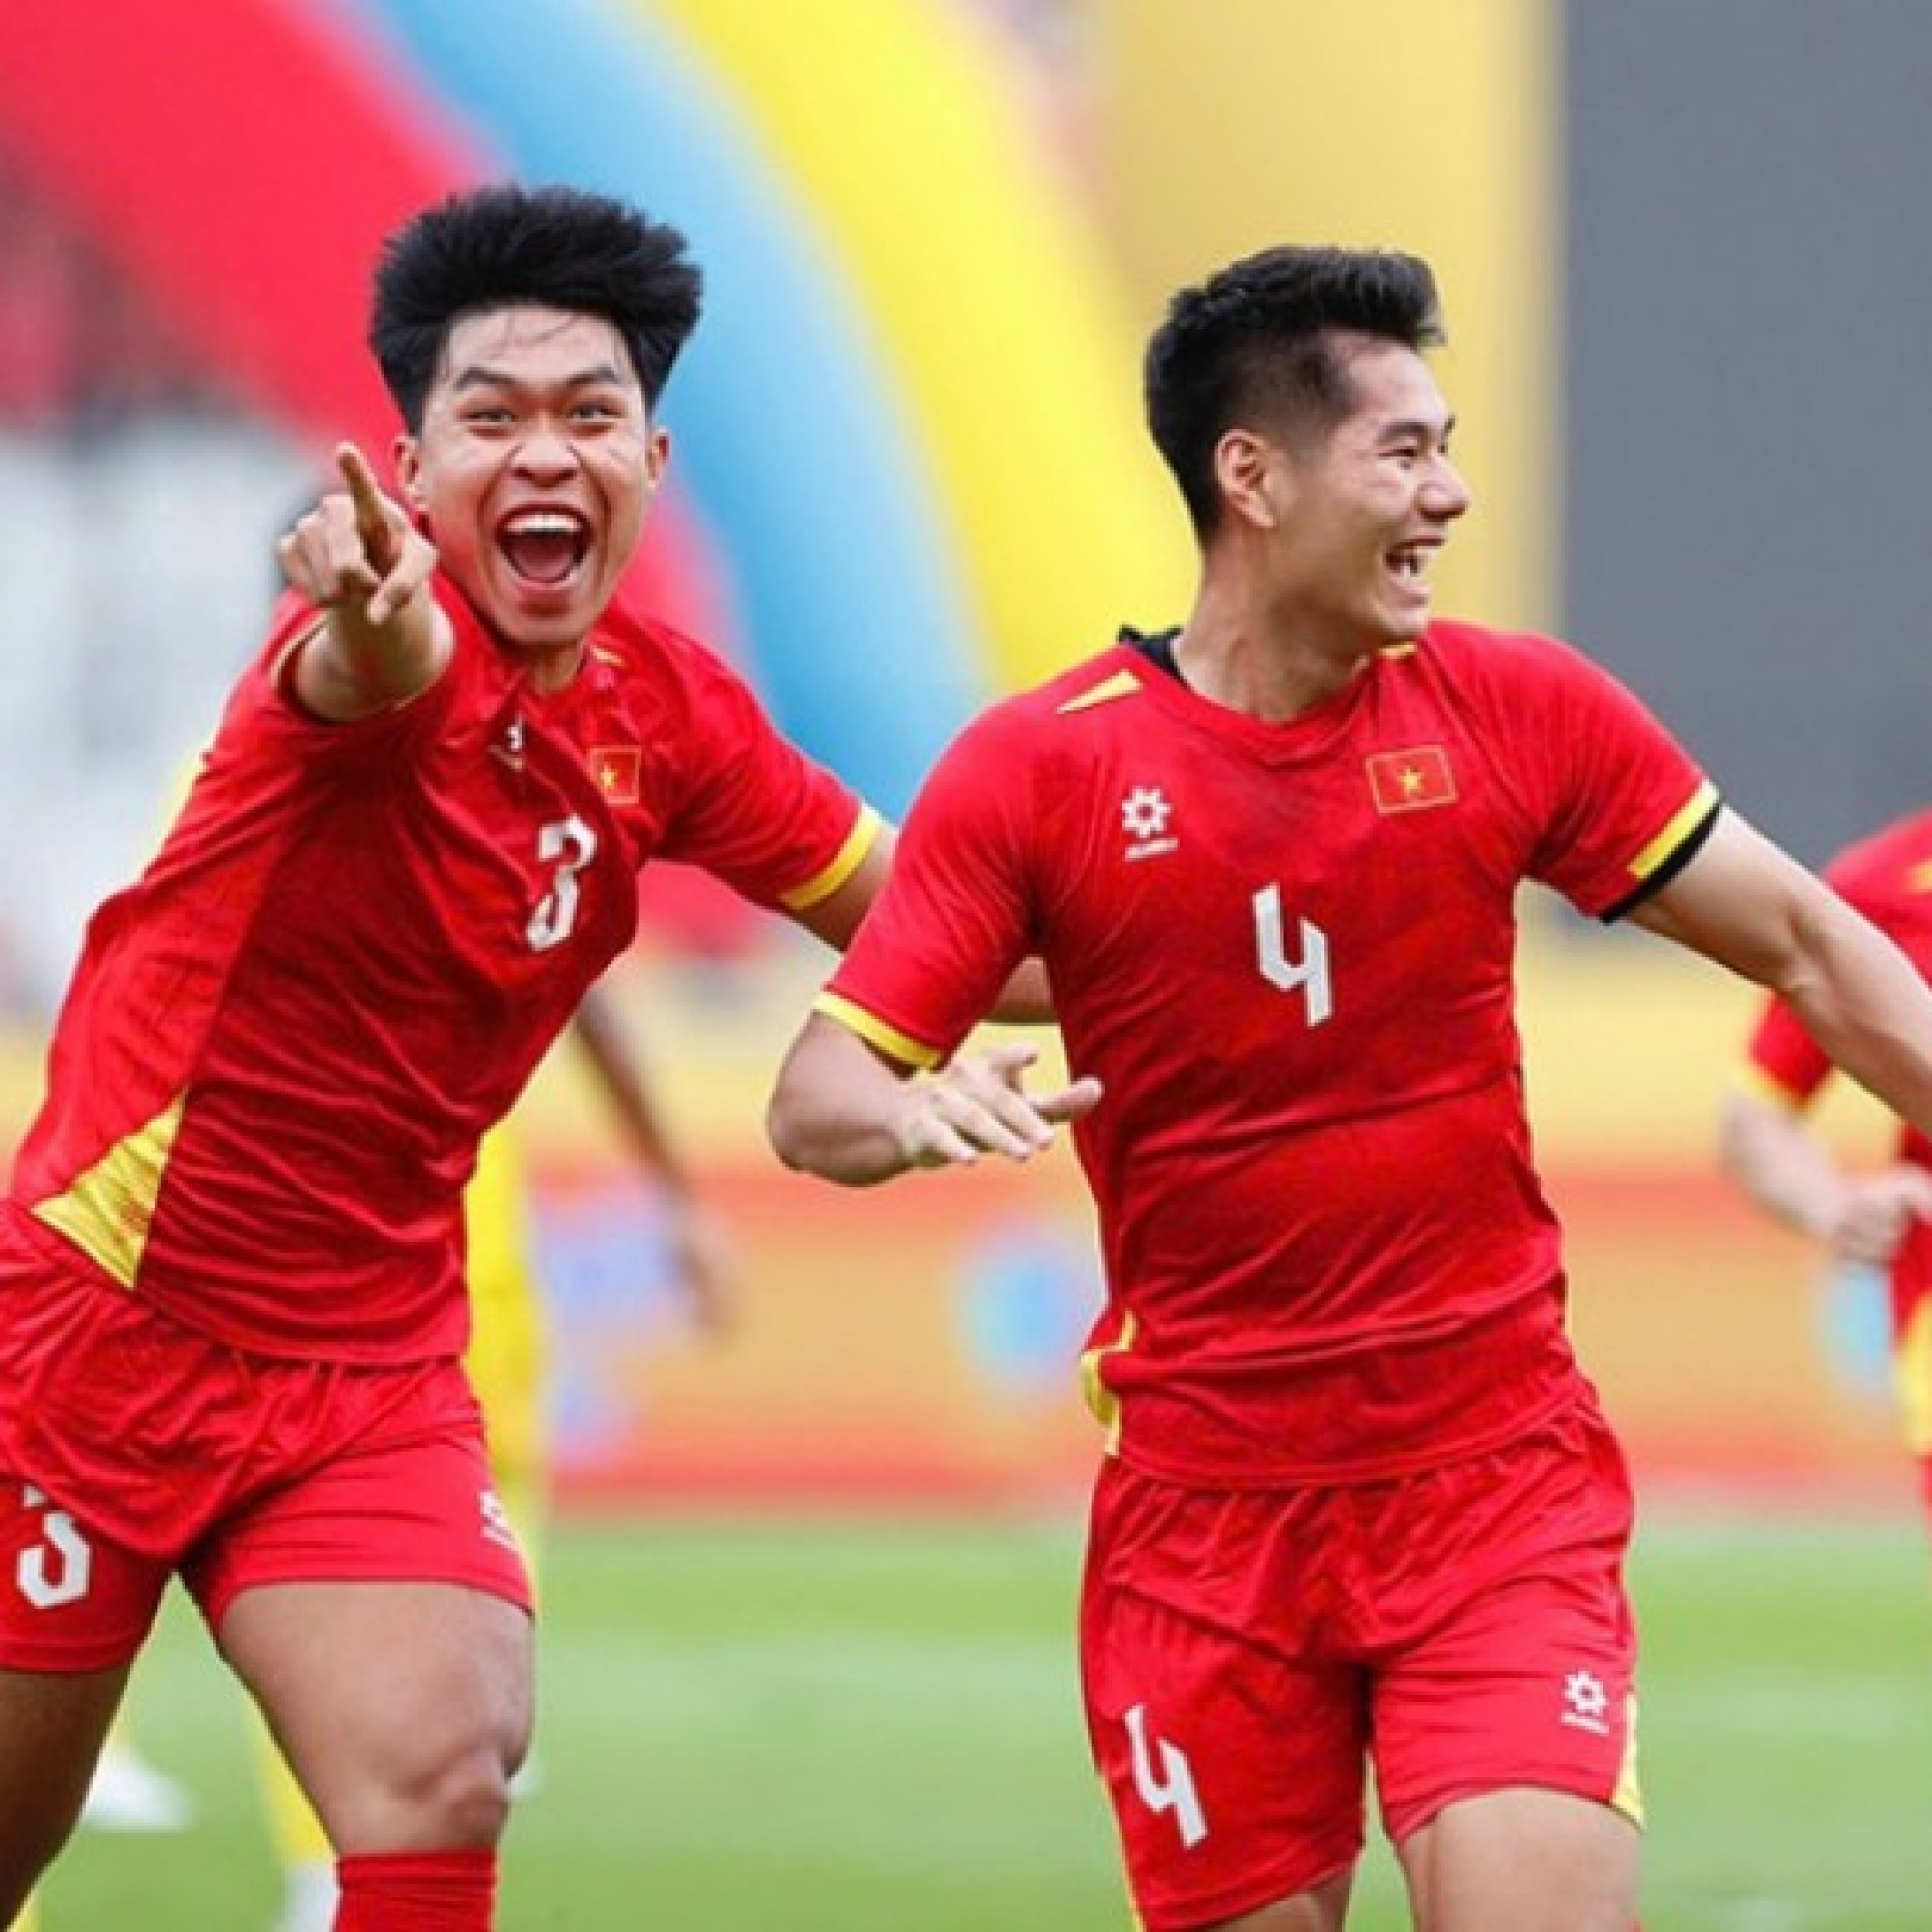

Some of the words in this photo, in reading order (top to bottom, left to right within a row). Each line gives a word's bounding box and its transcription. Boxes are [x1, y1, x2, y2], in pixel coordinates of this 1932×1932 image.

[526, 815, 596, 951] 3
[1253, 882, 1332, 1026] 4
[1124, 1703, 1208, 1849] 4
